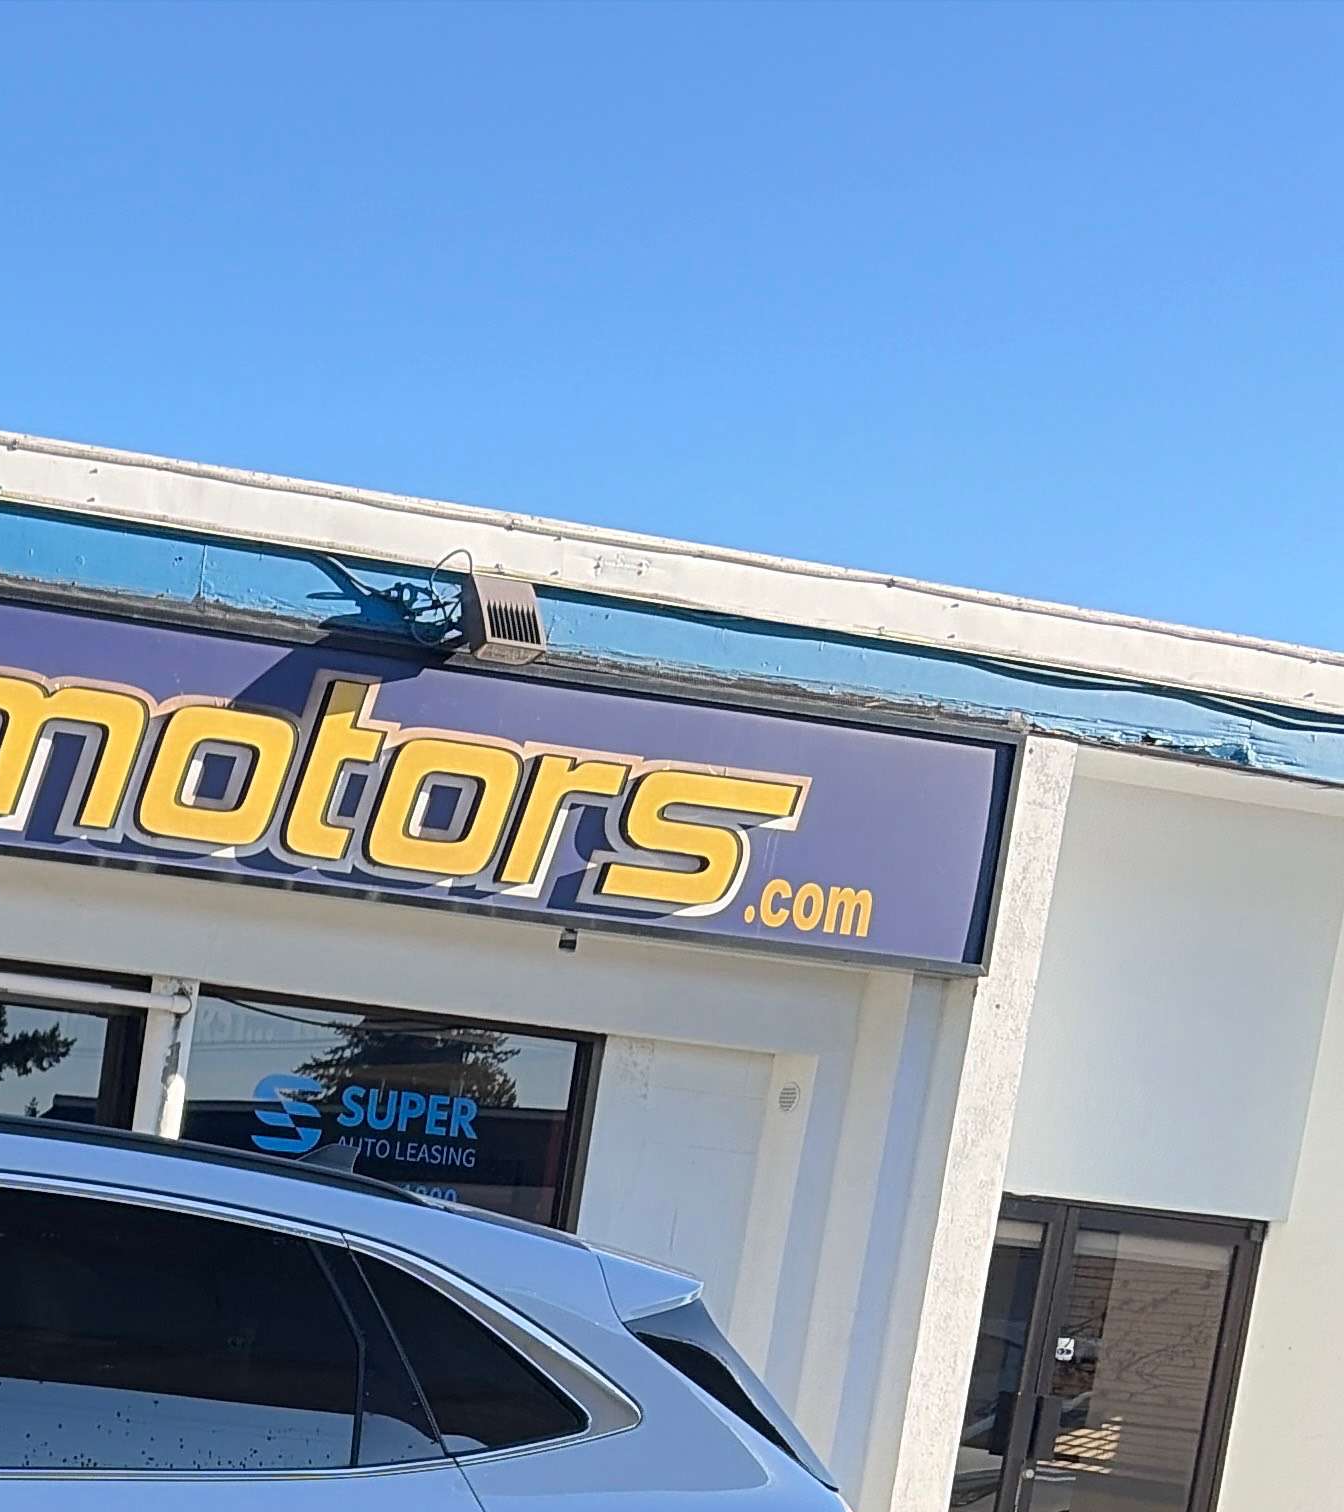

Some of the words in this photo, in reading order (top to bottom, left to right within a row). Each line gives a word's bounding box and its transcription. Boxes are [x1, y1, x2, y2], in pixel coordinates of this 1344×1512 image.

[743, 878, 873, 937] .com
[337, 1084, 478, 1140] SUPER
[395, 1141, 477, 1169] LEASING
